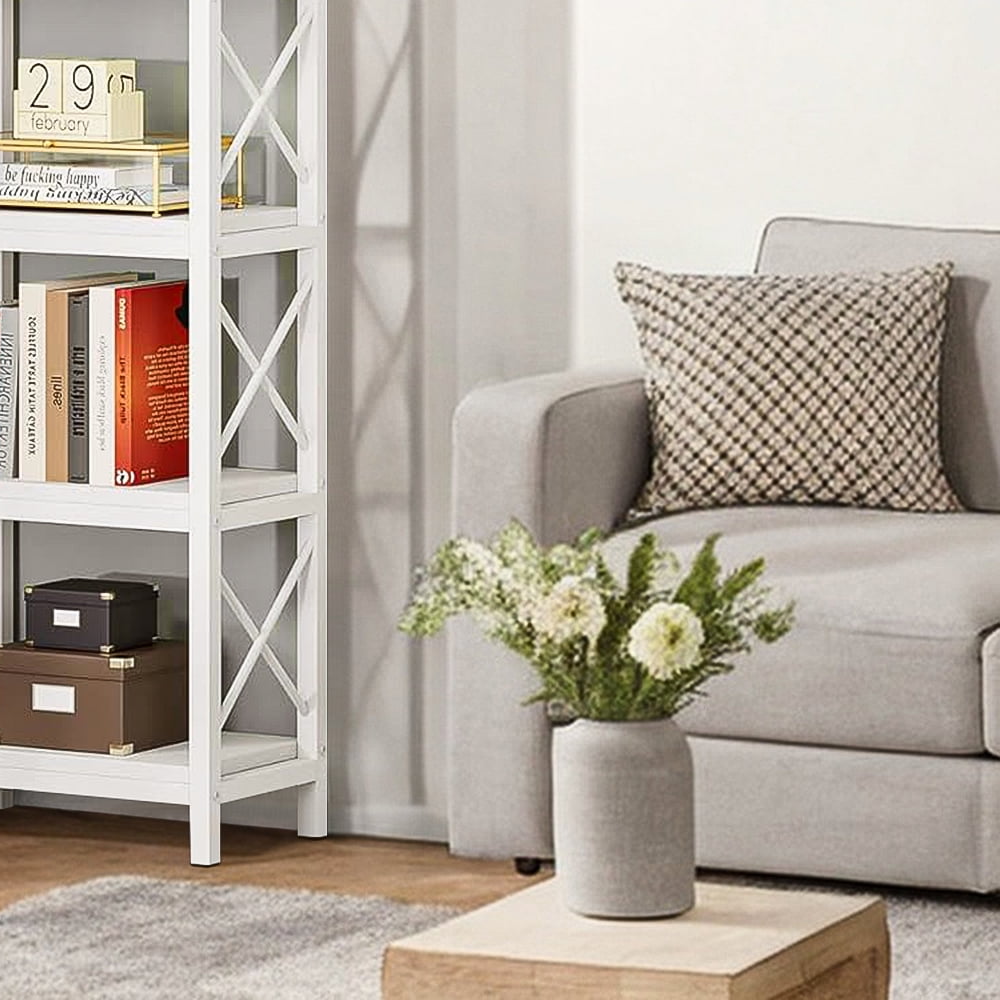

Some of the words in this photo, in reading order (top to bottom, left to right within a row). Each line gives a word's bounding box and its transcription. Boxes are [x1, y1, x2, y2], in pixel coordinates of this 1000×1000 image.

[31, 112, 90, 136] february
[4, 164, 17, 182] be
[20, 166, 63, 189] fucking
[65, 168, 100, 188] happy
